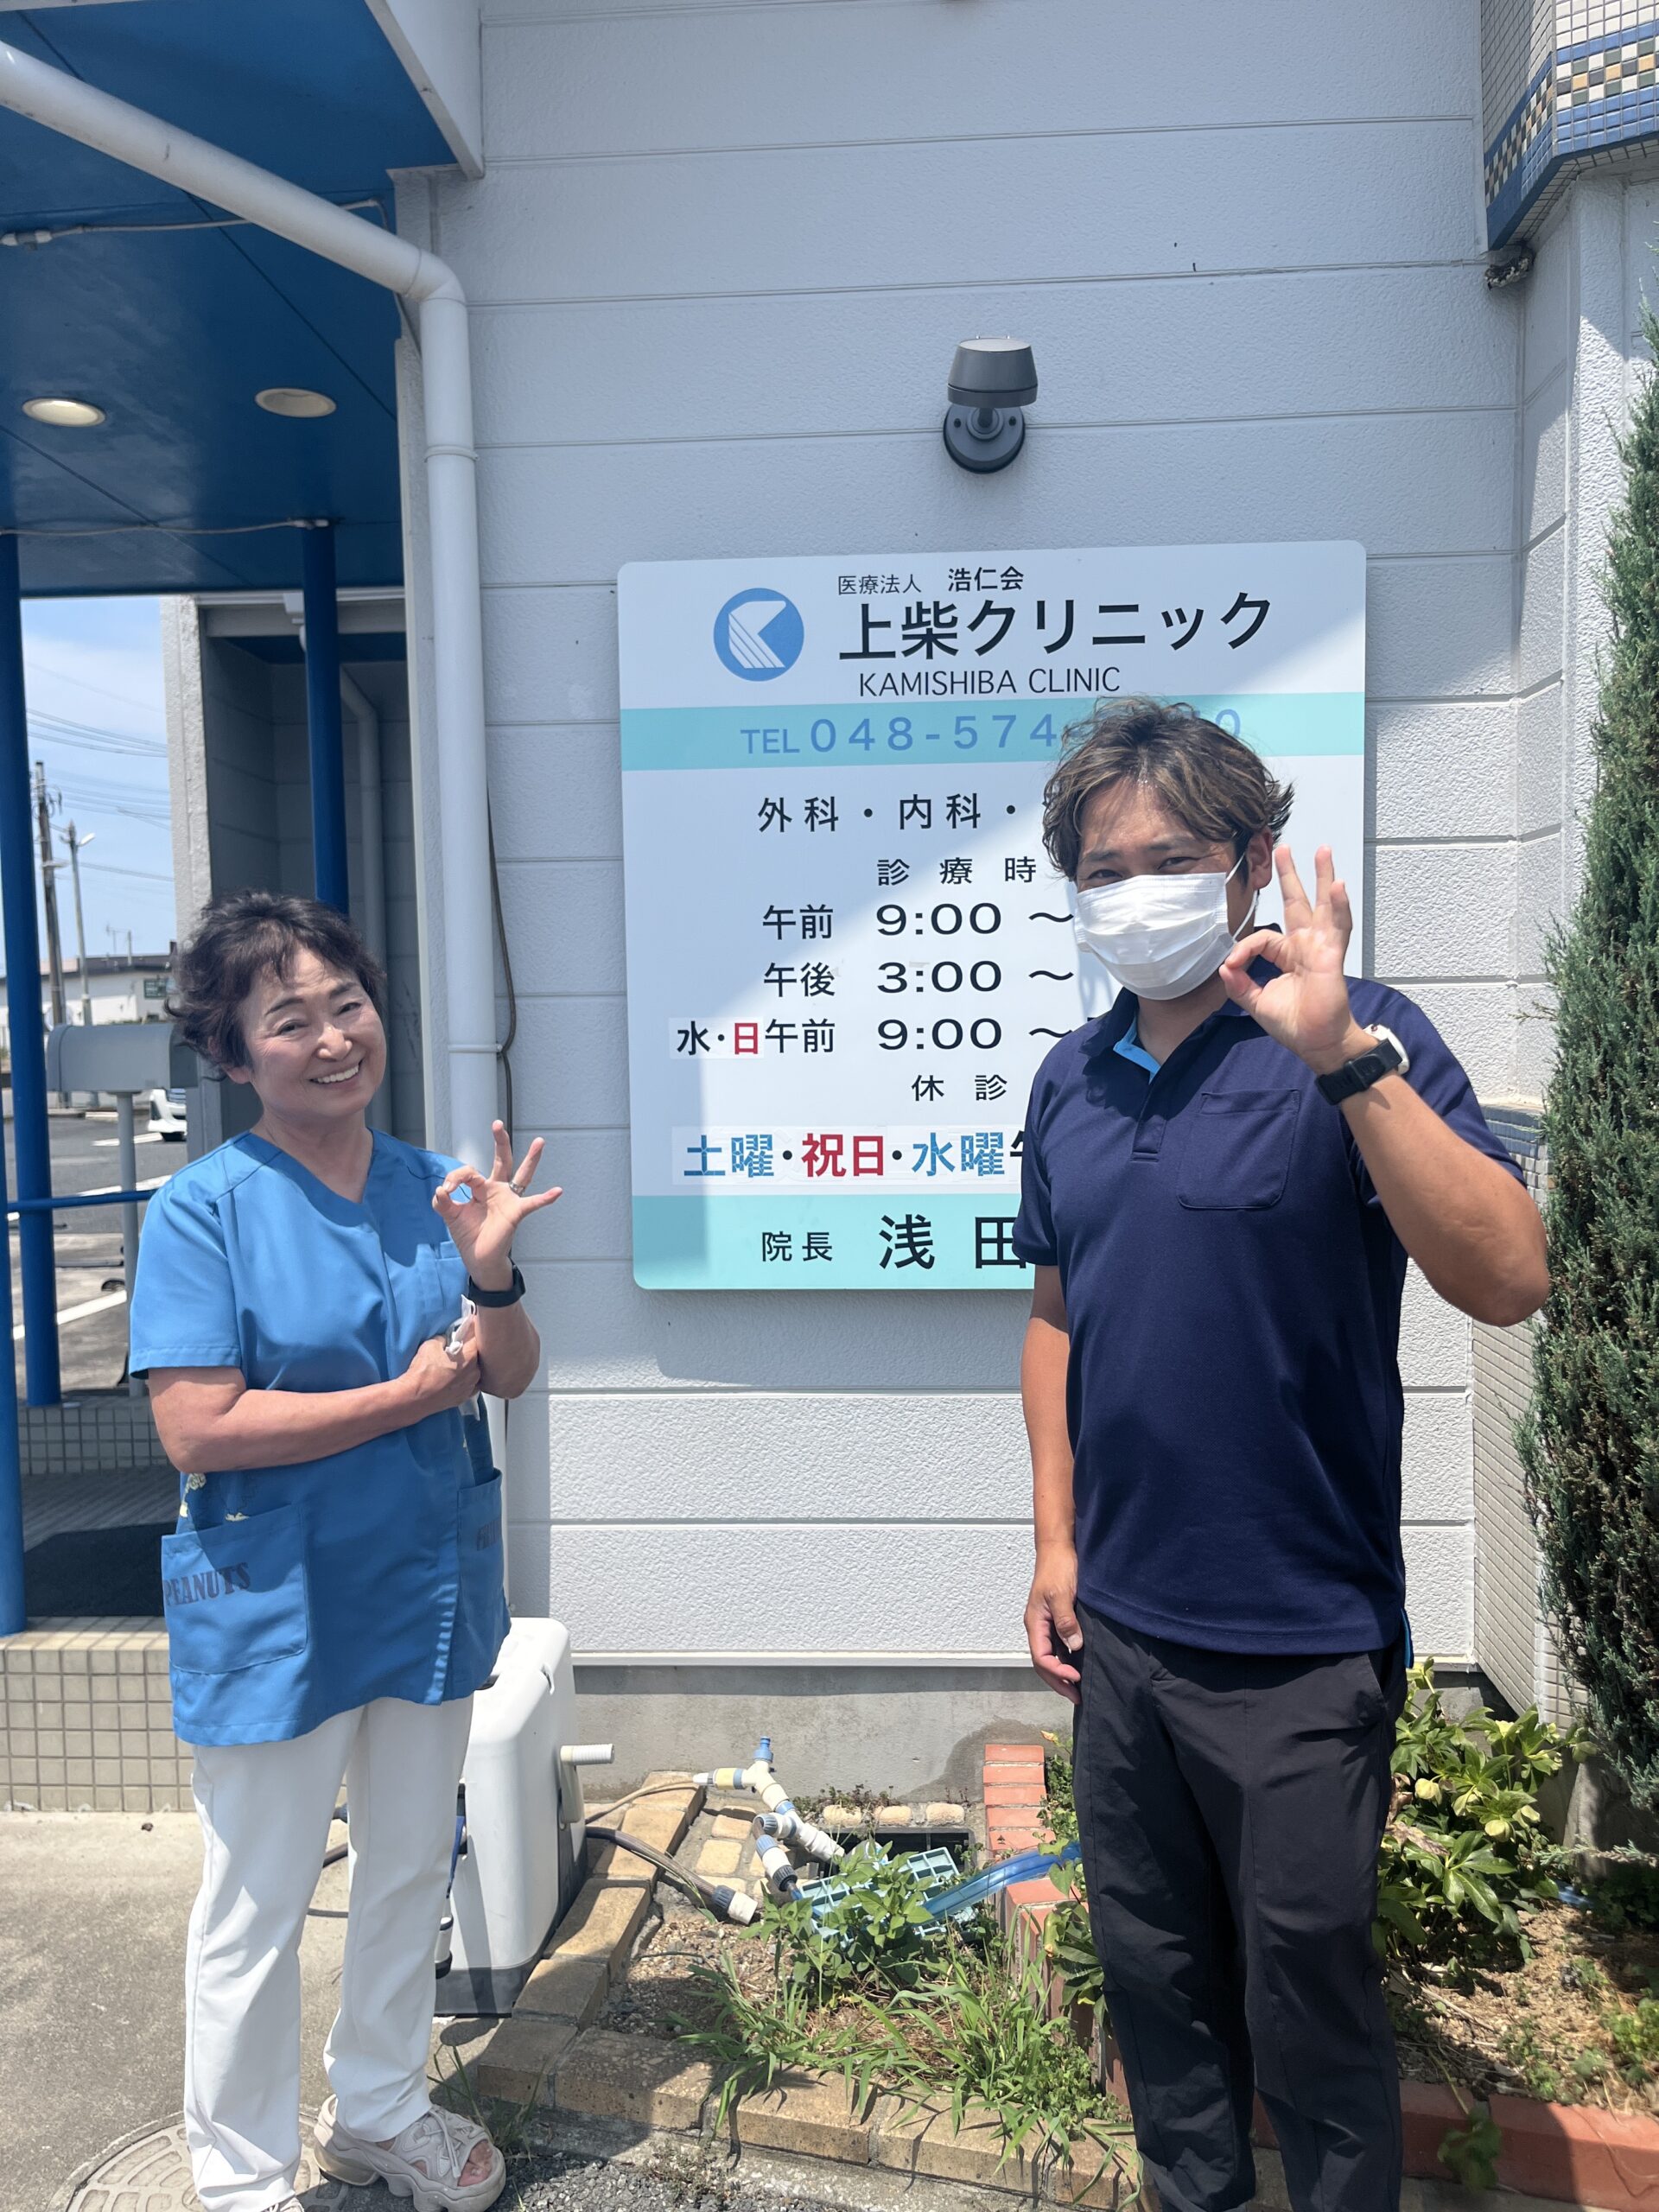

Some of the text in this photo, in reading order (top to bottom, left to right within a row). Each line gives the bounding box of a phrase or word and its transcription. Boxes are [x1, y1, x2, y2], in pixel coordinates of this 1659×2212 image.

[838, 565, 1025, 595] 医療法人 浩仁会
[838, 591, 1272, 660] 上柴クリニック
[859, 666, 1122, 697] KAMISHIBA CLINIC
[740, 728, 800, 754] TEL
[762, 903, 834, 941] 午前
[876, 902, 1002, 937] 9:00
[763, 962, 836, 998] 午後
[877, 960, 1002, 994] 3:00
[877, 1017, 1002, 1051] 9:00
[911, 1074, 1009, 1102] 休診
[761, 1213, 1027, 1269] 院長 浅田
[163, 1561, 251, 1606] PEANUTS
